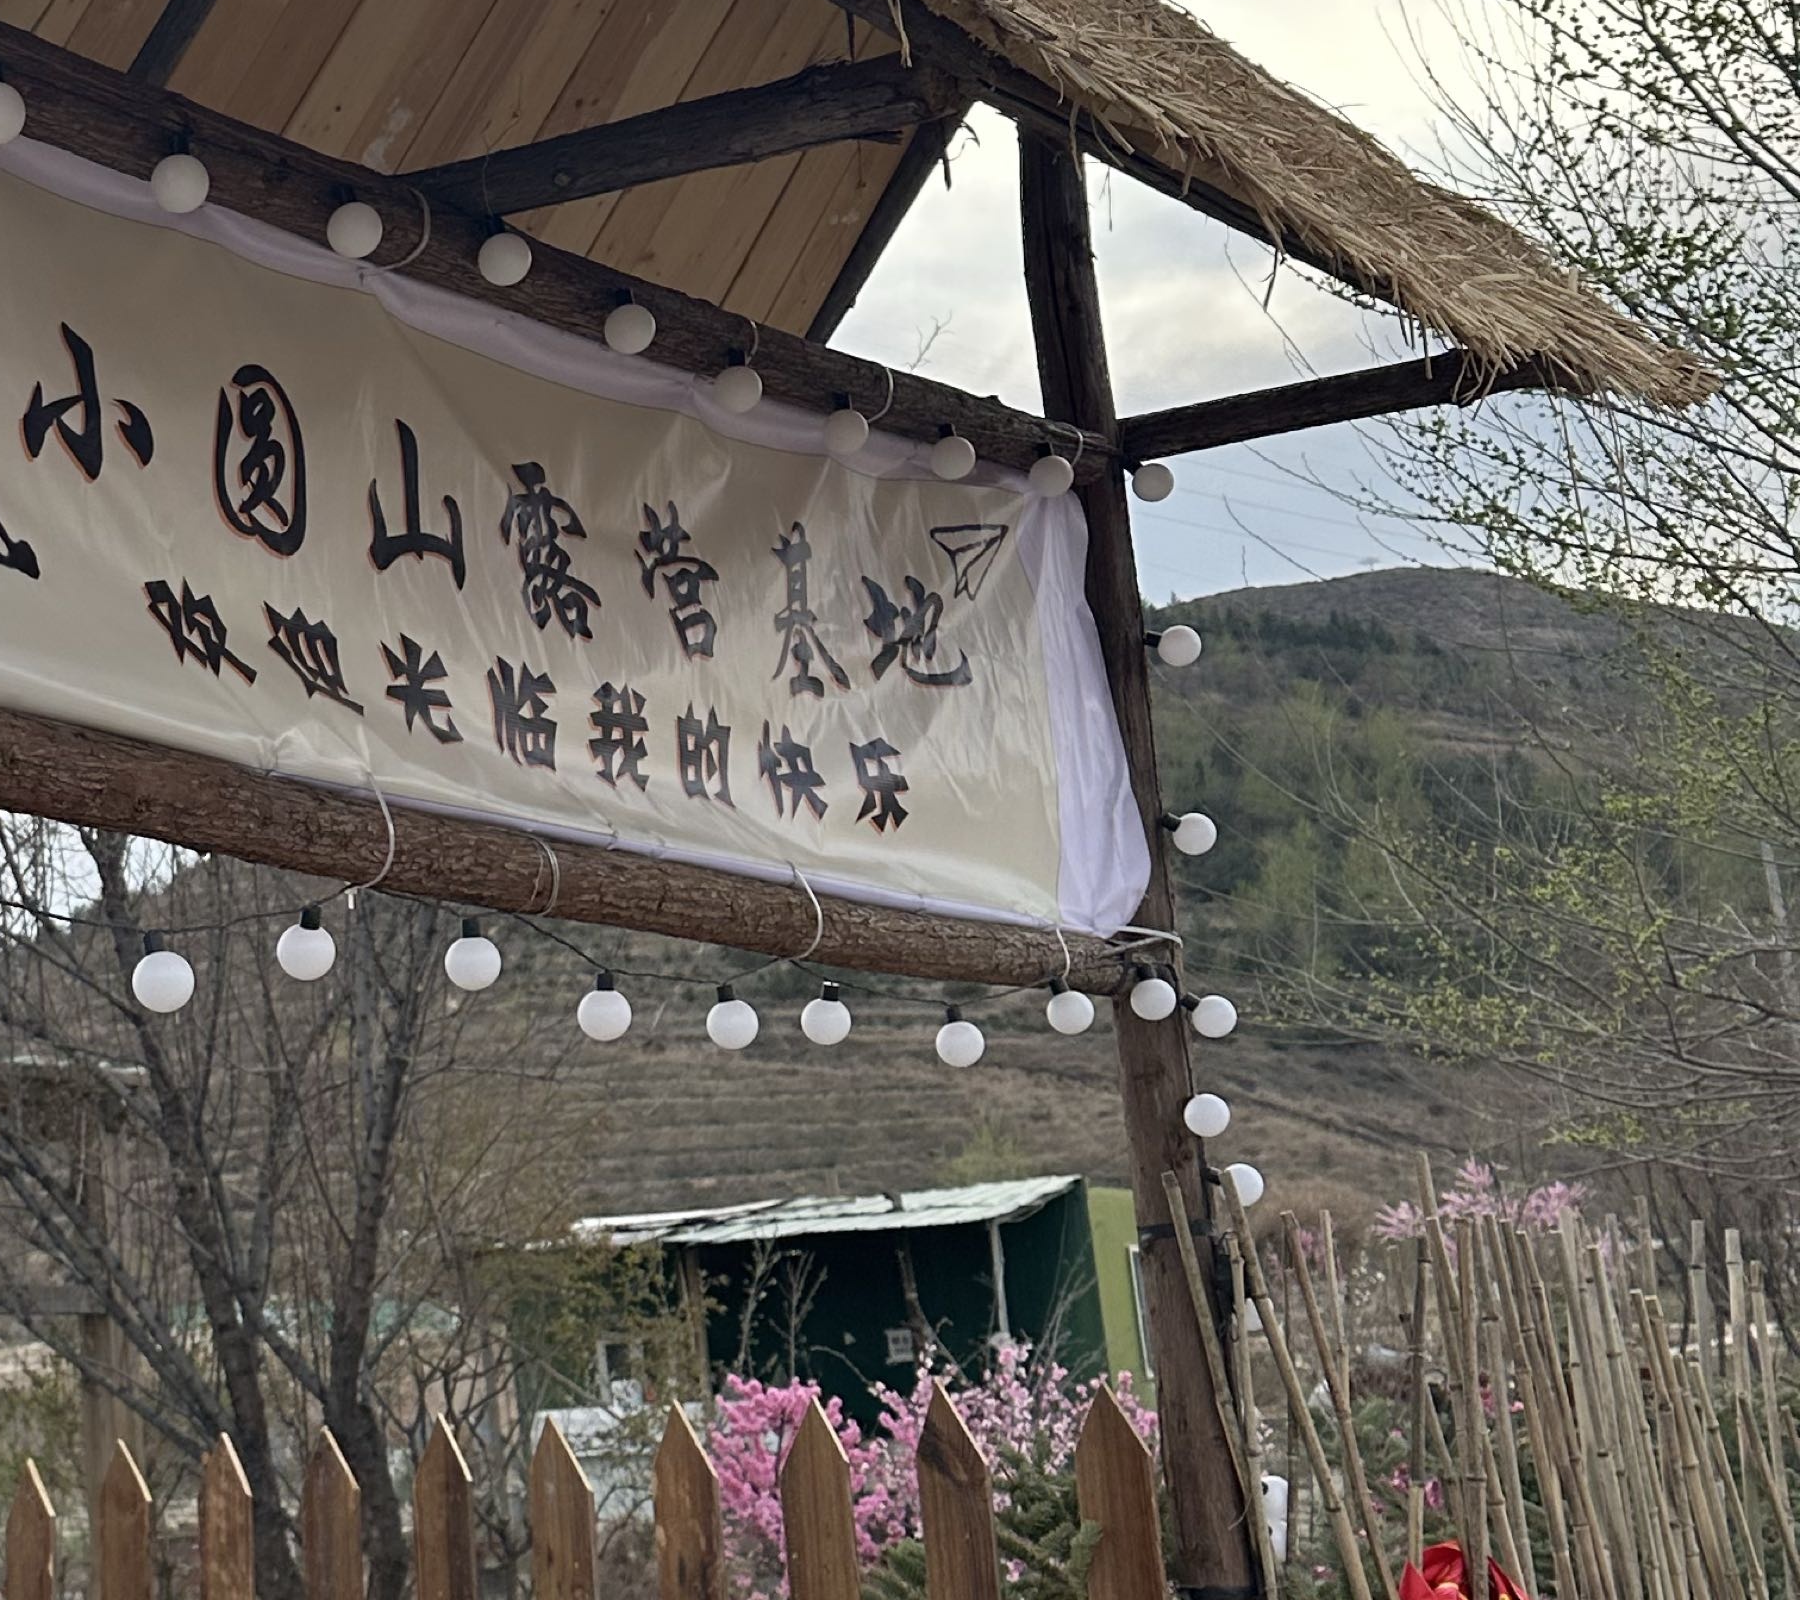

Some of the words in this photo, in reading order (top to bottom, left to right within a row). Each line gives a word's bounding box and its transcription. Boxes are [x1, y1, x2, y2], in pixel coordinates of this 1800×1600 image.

[20, 321, 973, 699] 小圆山露营基地
[142, 576, 911, 835] 欢迎光临我的快乐
